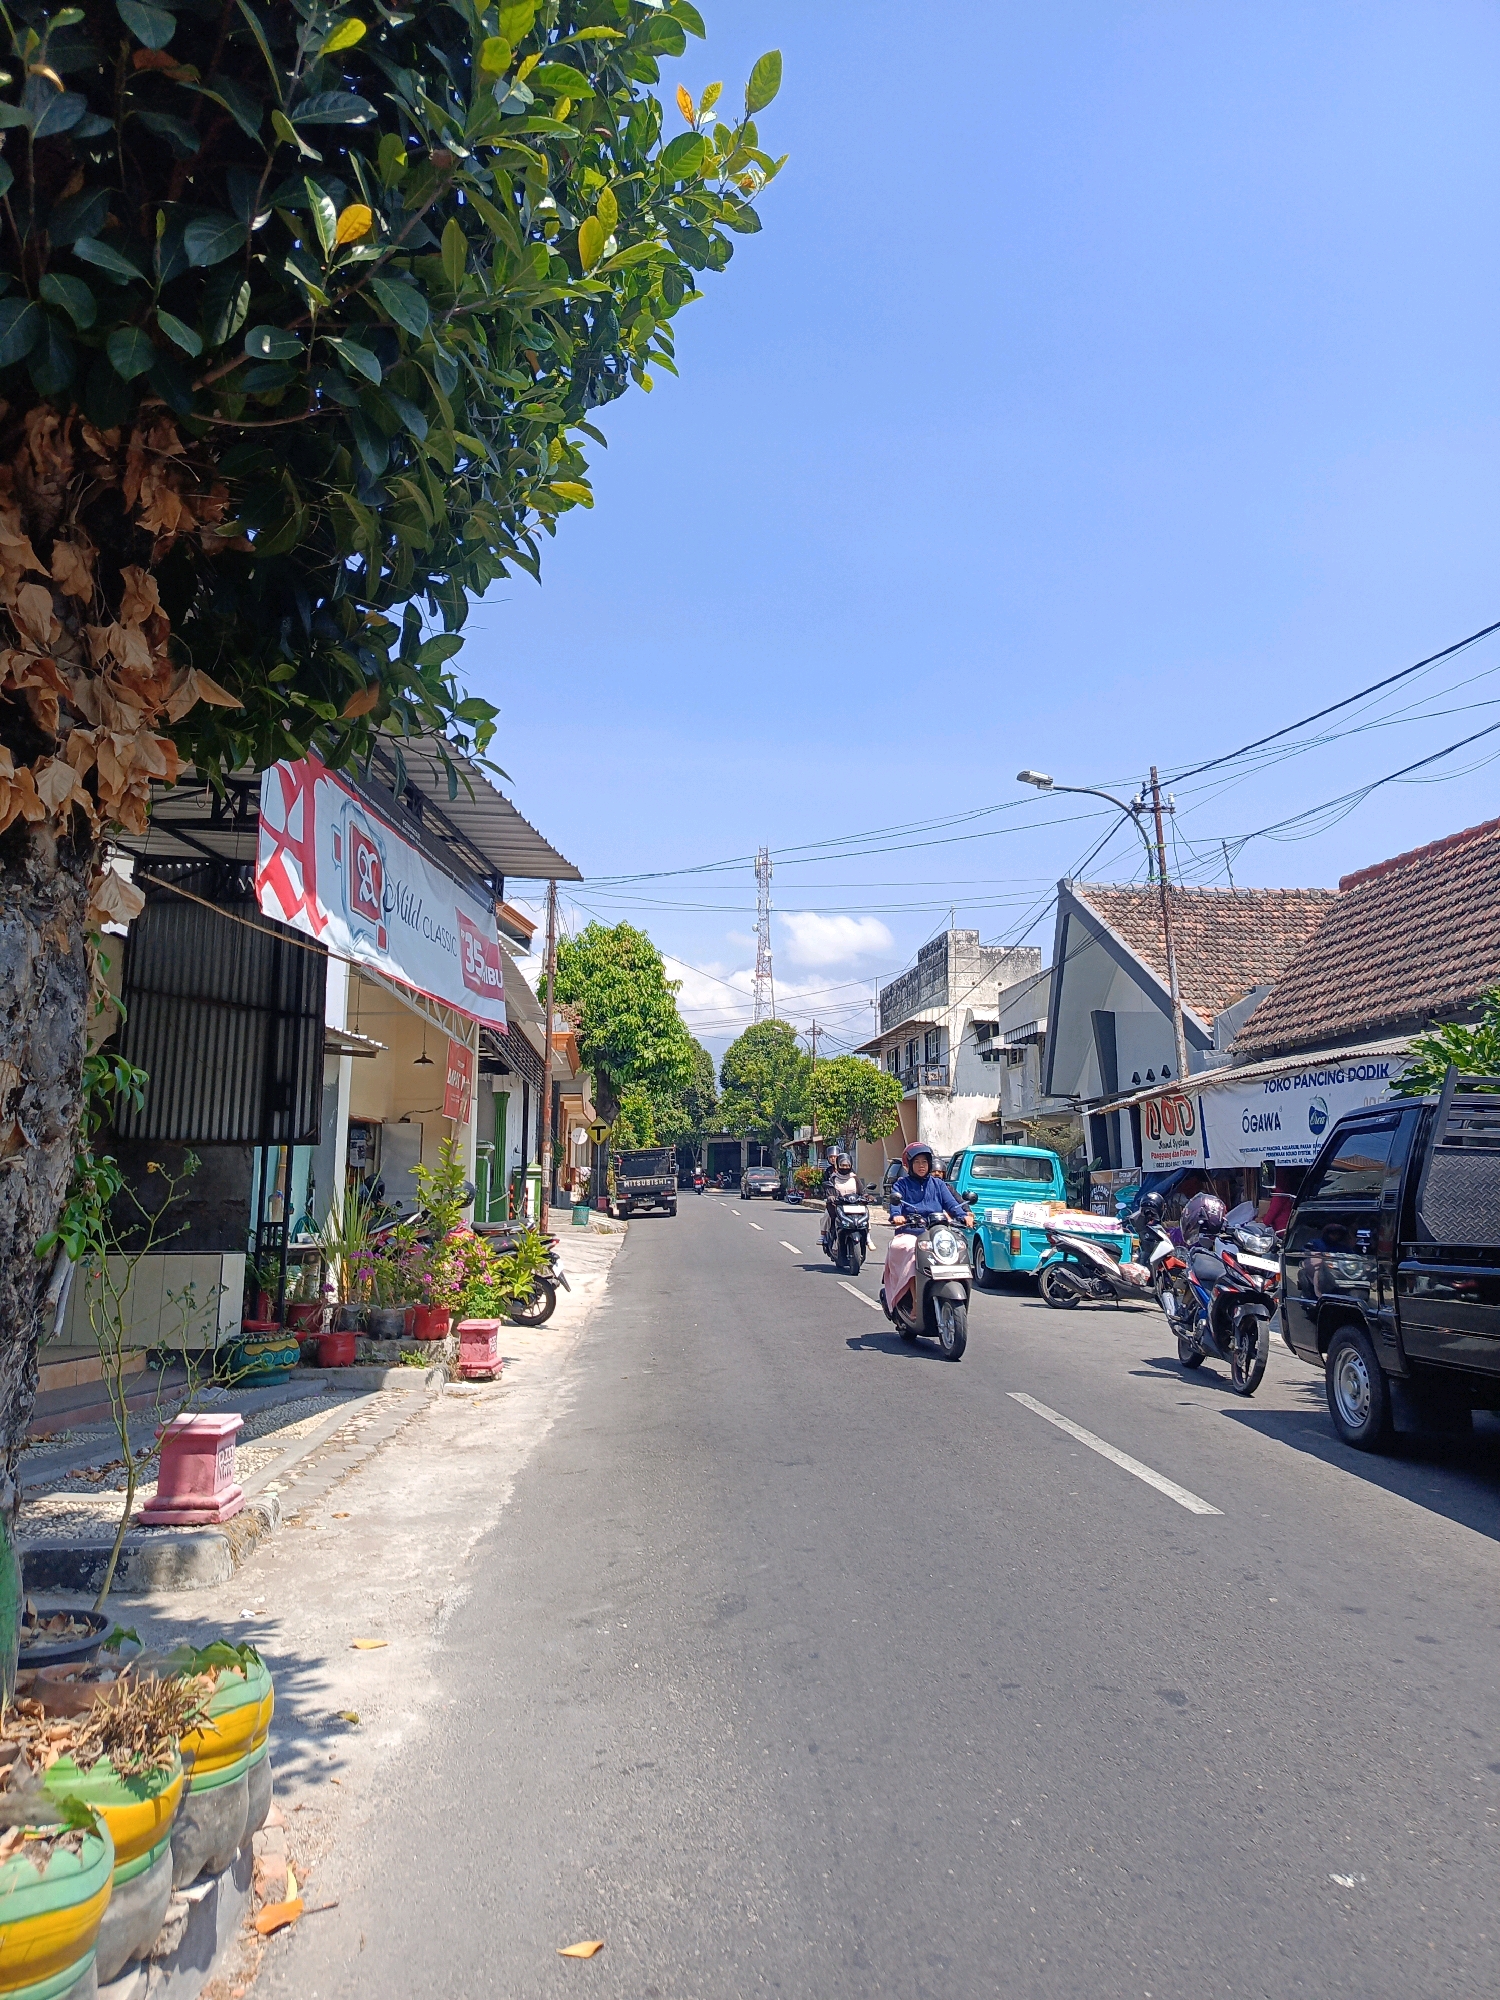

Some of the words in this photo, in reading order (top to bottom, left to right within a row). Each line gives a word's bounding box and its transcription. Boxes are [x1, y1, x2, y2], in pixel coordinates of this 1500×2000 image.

[383, 880, 423, 931] Mild
[422, 916, 457, 957] CLASSIC
[465, 931, 485, 977] 35
[1263, 1078, 1291, 1093] TOKO
[1294, 1070, 1345, 1089] PANCING
[1348, 1063, 1390, 1082] DODIK
[1242, 1110, 1282, 1133] OGAWA
[624, 1178, 667, 1187] MITSUBISHI
